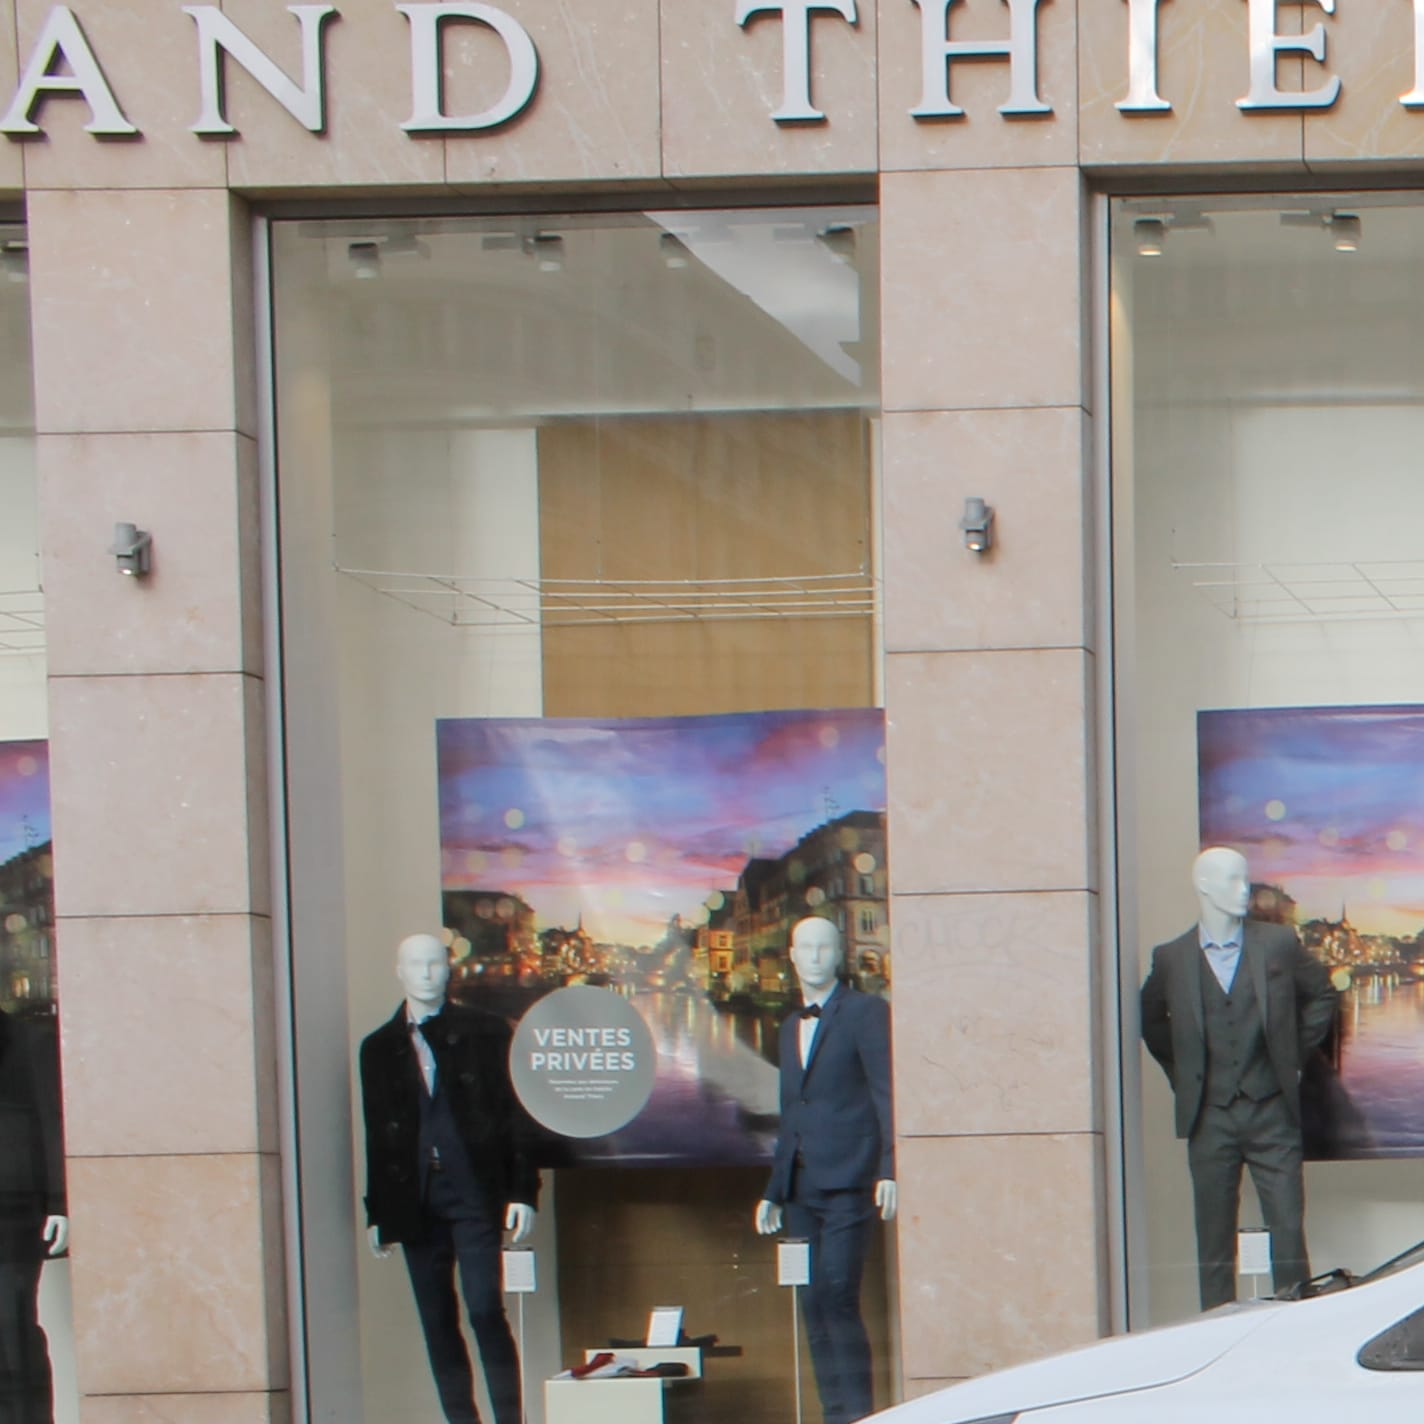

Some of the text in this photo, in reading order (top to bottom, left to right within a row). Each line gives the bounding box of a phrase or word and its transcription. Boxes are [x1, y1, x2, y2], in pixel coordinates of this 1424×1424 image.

[0, 3, 542, 136] AND
[533, 1027, 632, 1048] VENTES
[530, 1048, 636, 1071] PRIVÉES
